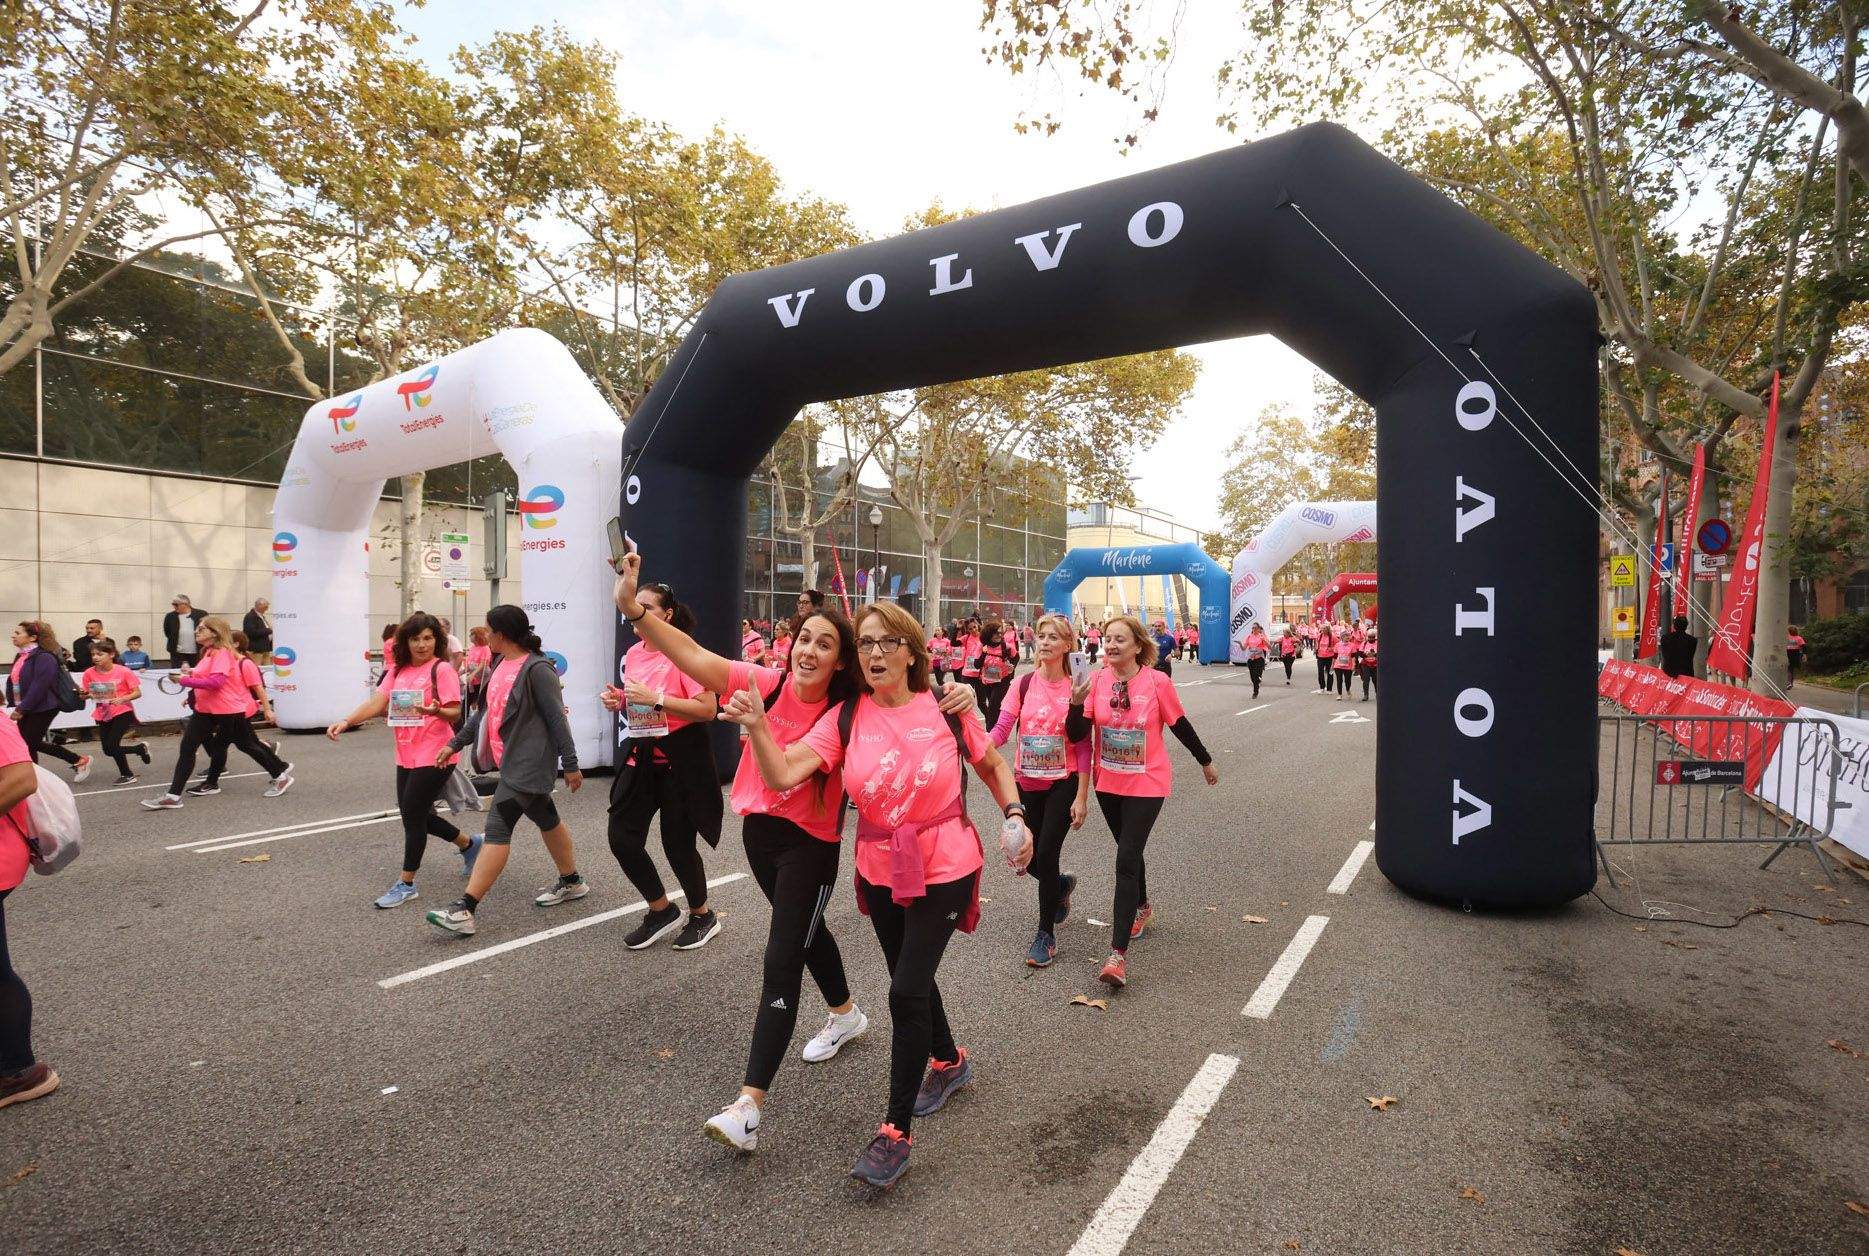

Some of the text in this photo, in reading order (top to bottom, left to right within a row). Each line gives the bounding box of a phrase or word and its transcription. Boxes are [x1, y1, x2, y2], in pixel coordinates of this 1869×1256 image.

[767, 201, 1184, 328] VOLVO
[1301, 507, 1334, 526] COSMO
[521, 538, 566, 552] Energies
[1232, 574, 1256, 600] COSMO
[1231, 606, 1253, 635] COSMO
[1452, 380, 1498, 845] VOLVO
